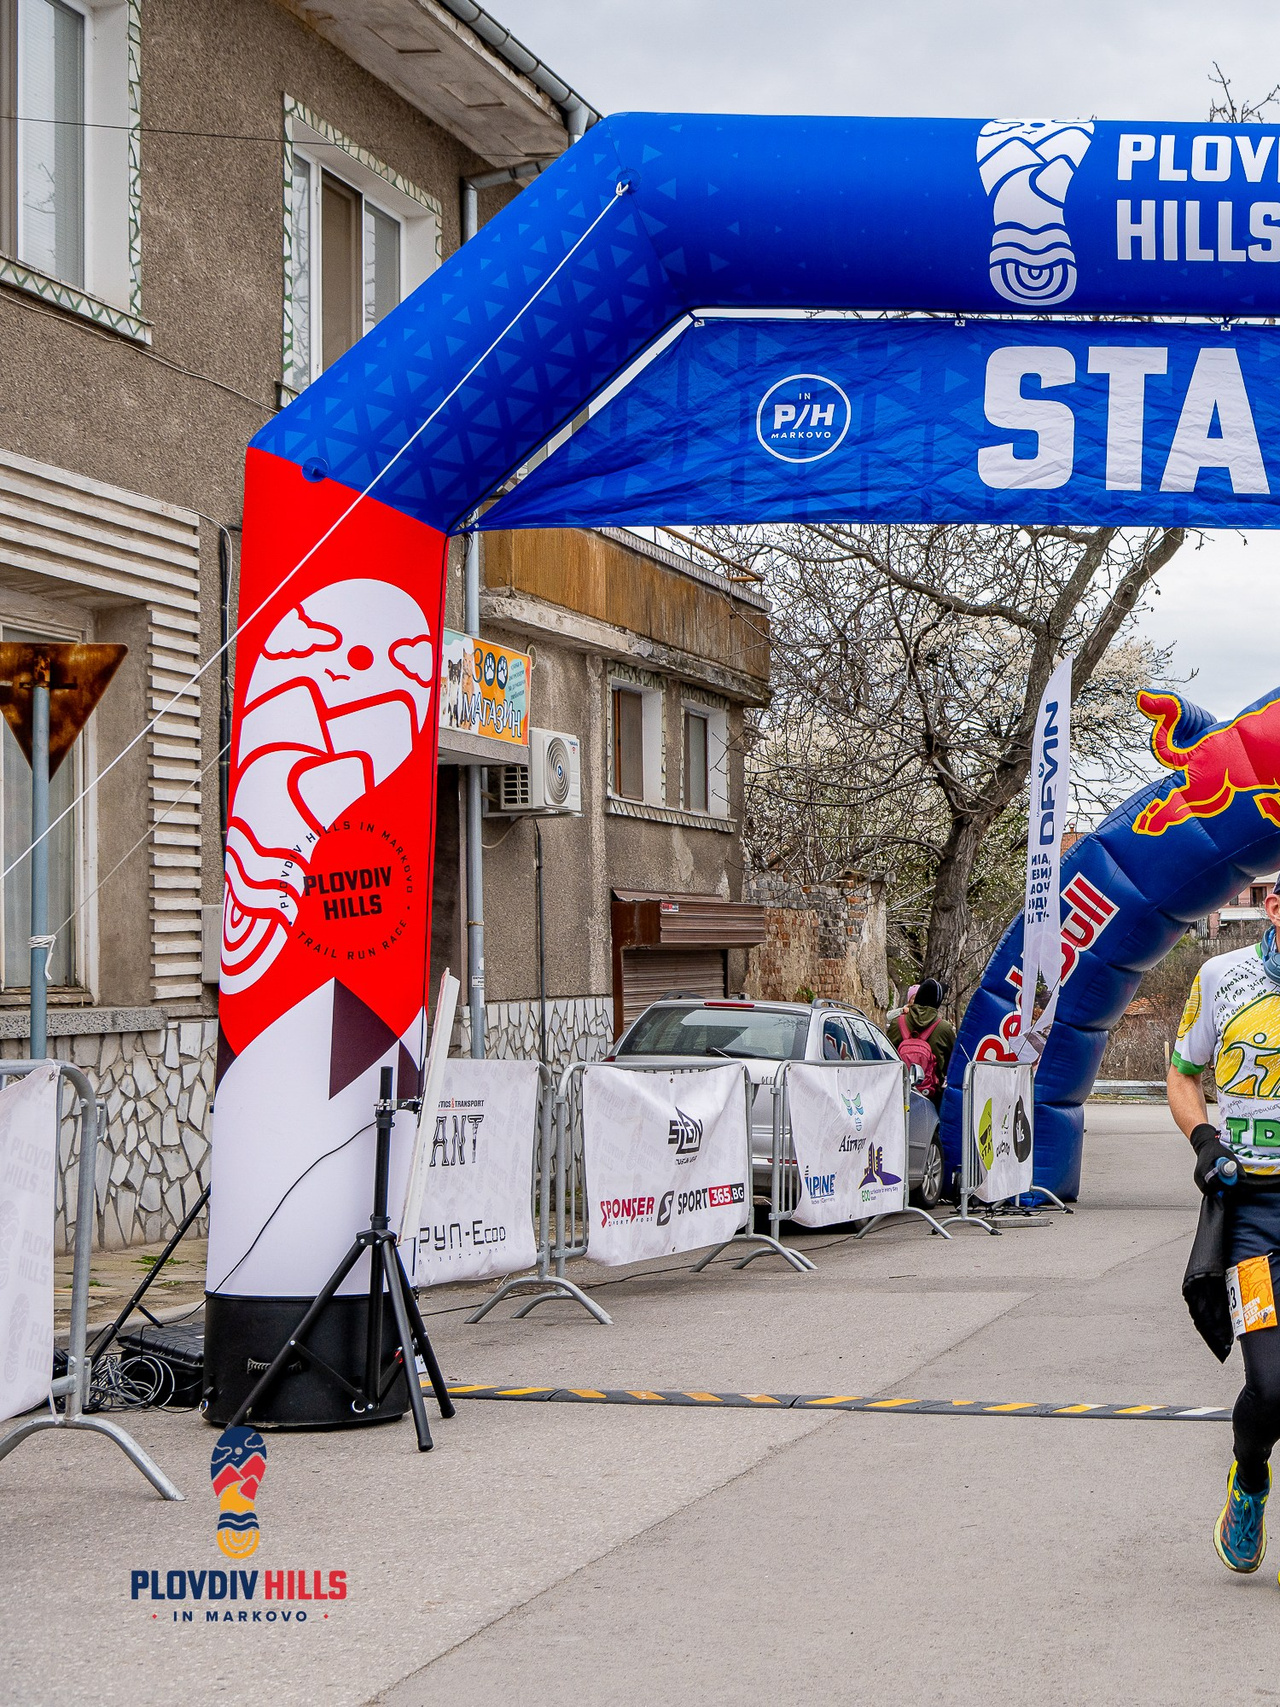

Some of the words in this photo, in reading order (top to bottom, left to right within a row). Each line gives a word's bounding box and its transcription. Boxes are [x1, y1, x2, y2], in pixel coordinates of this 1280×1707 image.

[798, 392, 811, 400] IN
[773, 403, 835, 430] P/H
[770, 431, 832, 439] MARKOVO
[462, 691, 522, 738] МАГАЗИН
[279, 843, 303, 910] PLOVDIV
[305, 820, 351, 844] HILLS
[359, 821, 376, 834] IN
[381, 829, 414, 894] MARKOVO
[302, 865, 392, 897] PLOVDIV
[323, 894, 383, 921] HILLS
[297, 930, 338, 959] TRAIL
[347, 947, 377, 961] RUN
[381, 919, 408, 950] RACE
[455, 1100, 484, 1108] TRANSPORT
[429, 1115, 484, 1167] ANT
[600, 1196, 655, 1228] SPONSER
[677, 1188, 708, 1215] SPORT
